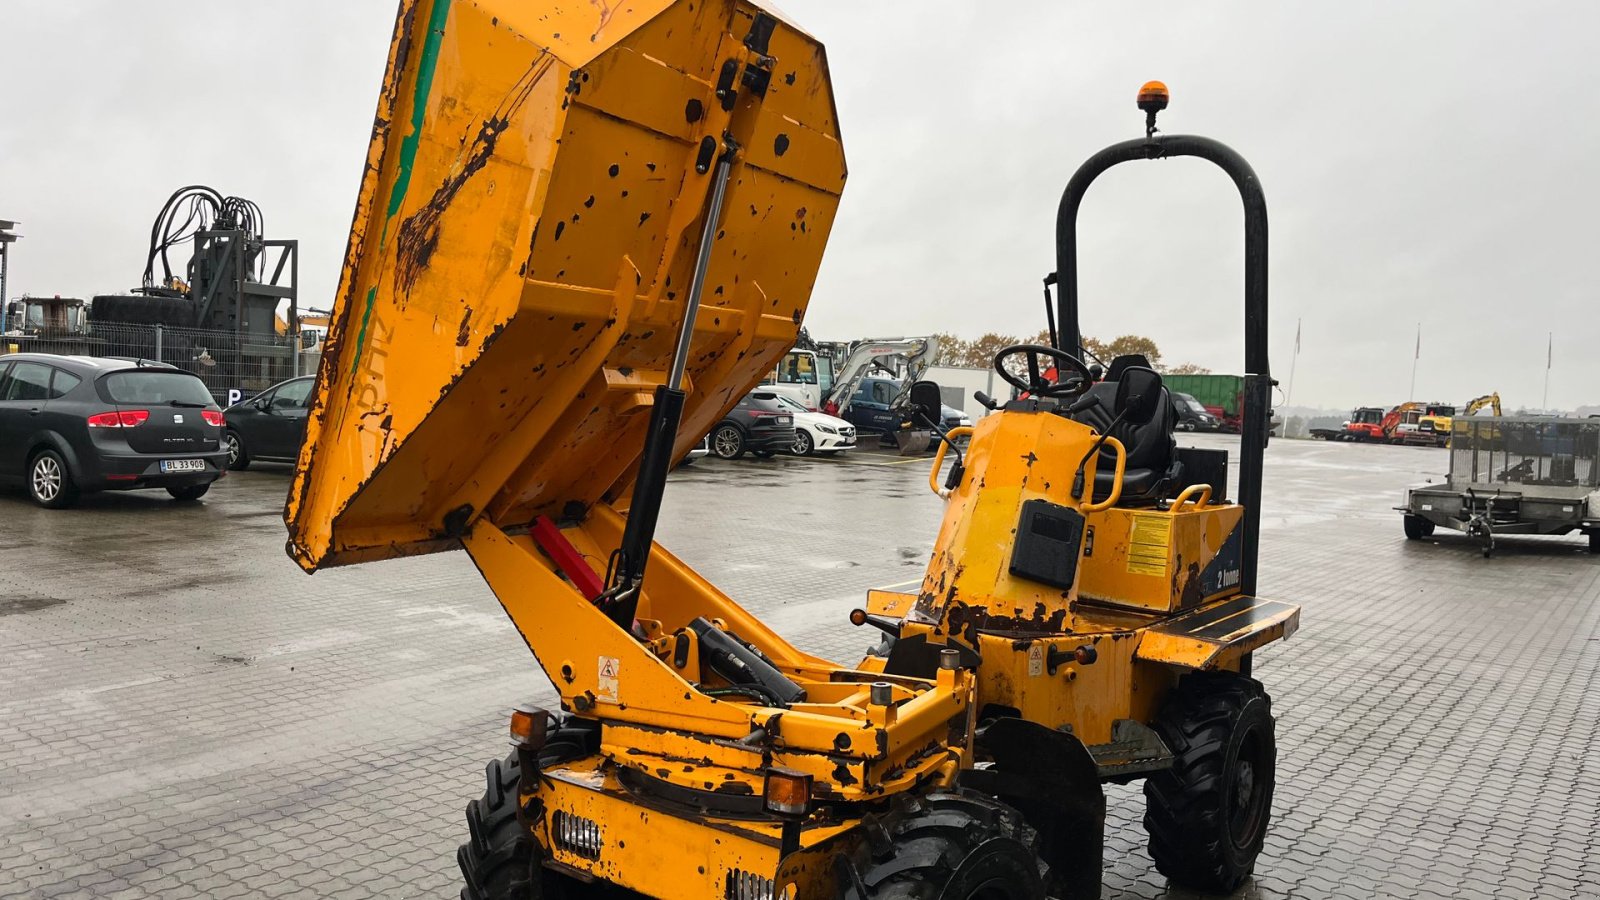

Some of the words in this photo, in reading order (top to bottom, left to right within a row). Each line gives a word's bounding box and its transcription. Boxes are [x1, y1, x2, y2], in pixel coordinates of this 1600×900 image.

[228, 389, 241, 406] P
[166, 461, 178, 470] BL
[180, 460, 188, 469] 33
[190, 460, 204, 469] 908
[1217, 570, 1223, 589] 2
